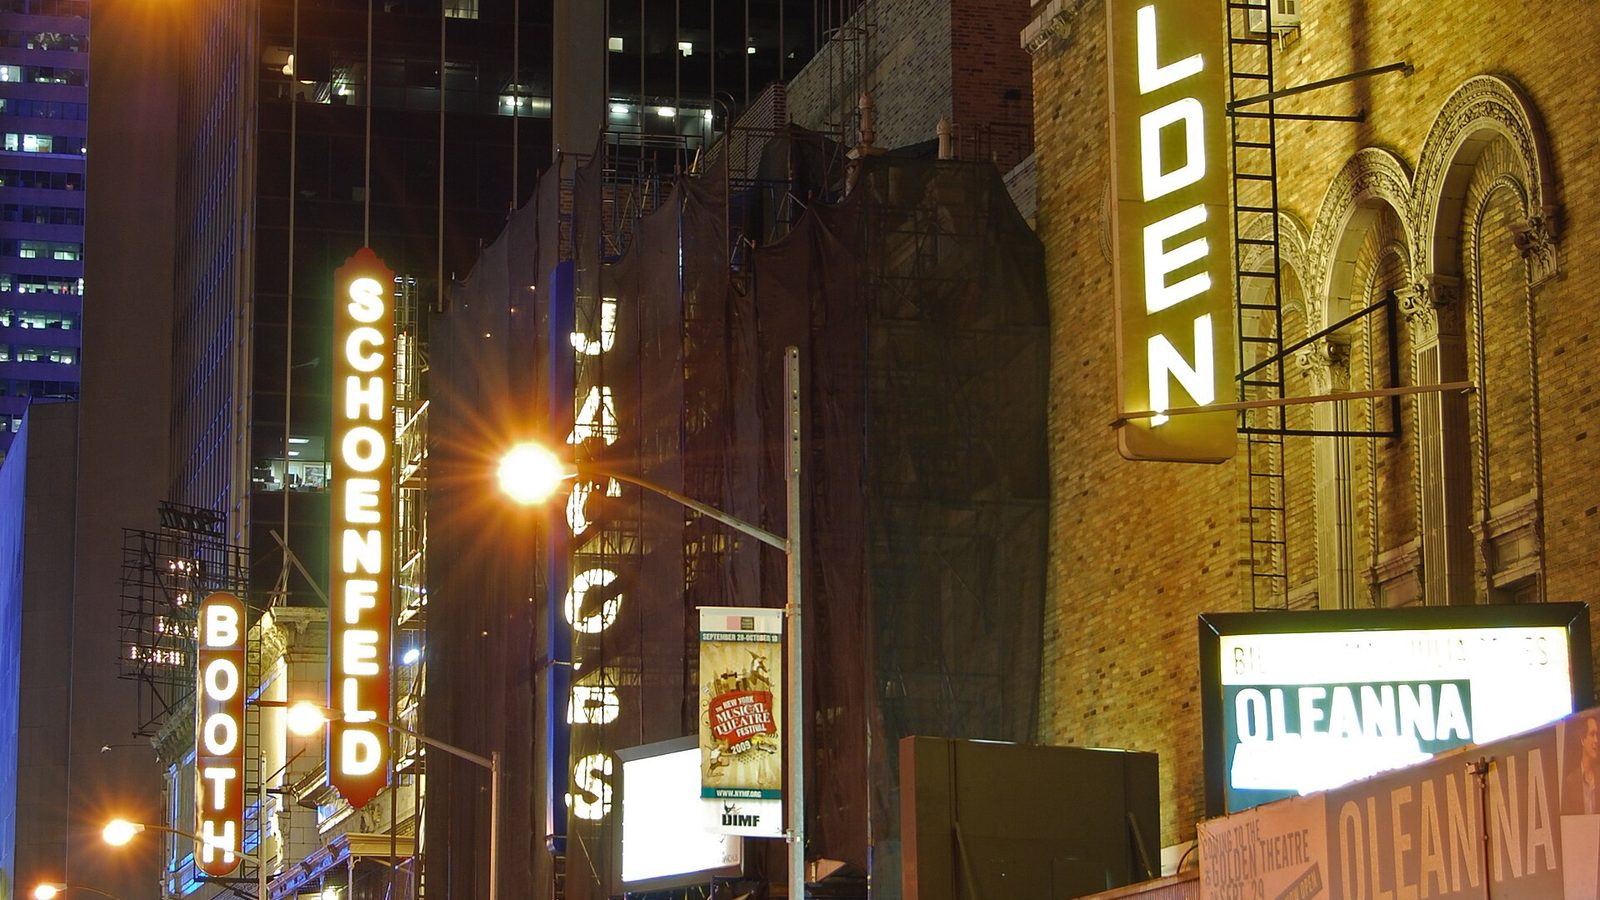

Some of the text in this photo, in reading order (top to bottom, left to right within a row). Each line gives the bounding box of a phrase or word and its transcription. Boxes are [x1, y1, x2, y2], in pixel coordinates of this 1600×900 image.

[1136, 4, 1215, 428] LDEN
[341, 277, 386, 776] SCHOENFELD
[716, 702, 766, 723] MUSICAL
[722, 698, 737, 709] NEW
[1235, 683, 1472, 744] OLEANNA
[204, 604, 239, 864] BOOTH
[714, 711, 771, 735] THEATRE
[736, 723, 767, 738] FESTIVAL
[731, 740, 752, 755] 2009
[721, 813, 760, 827] DIMF
[1234, 824, 1245, 848] TO
[1246, 819, 1261, 843] THE
[1338, 748, 1557, 900] OLEANNA
[1211, 842, 1258, 889] GOLDEN
[1260, 829, 1310, 873] THEATRE
